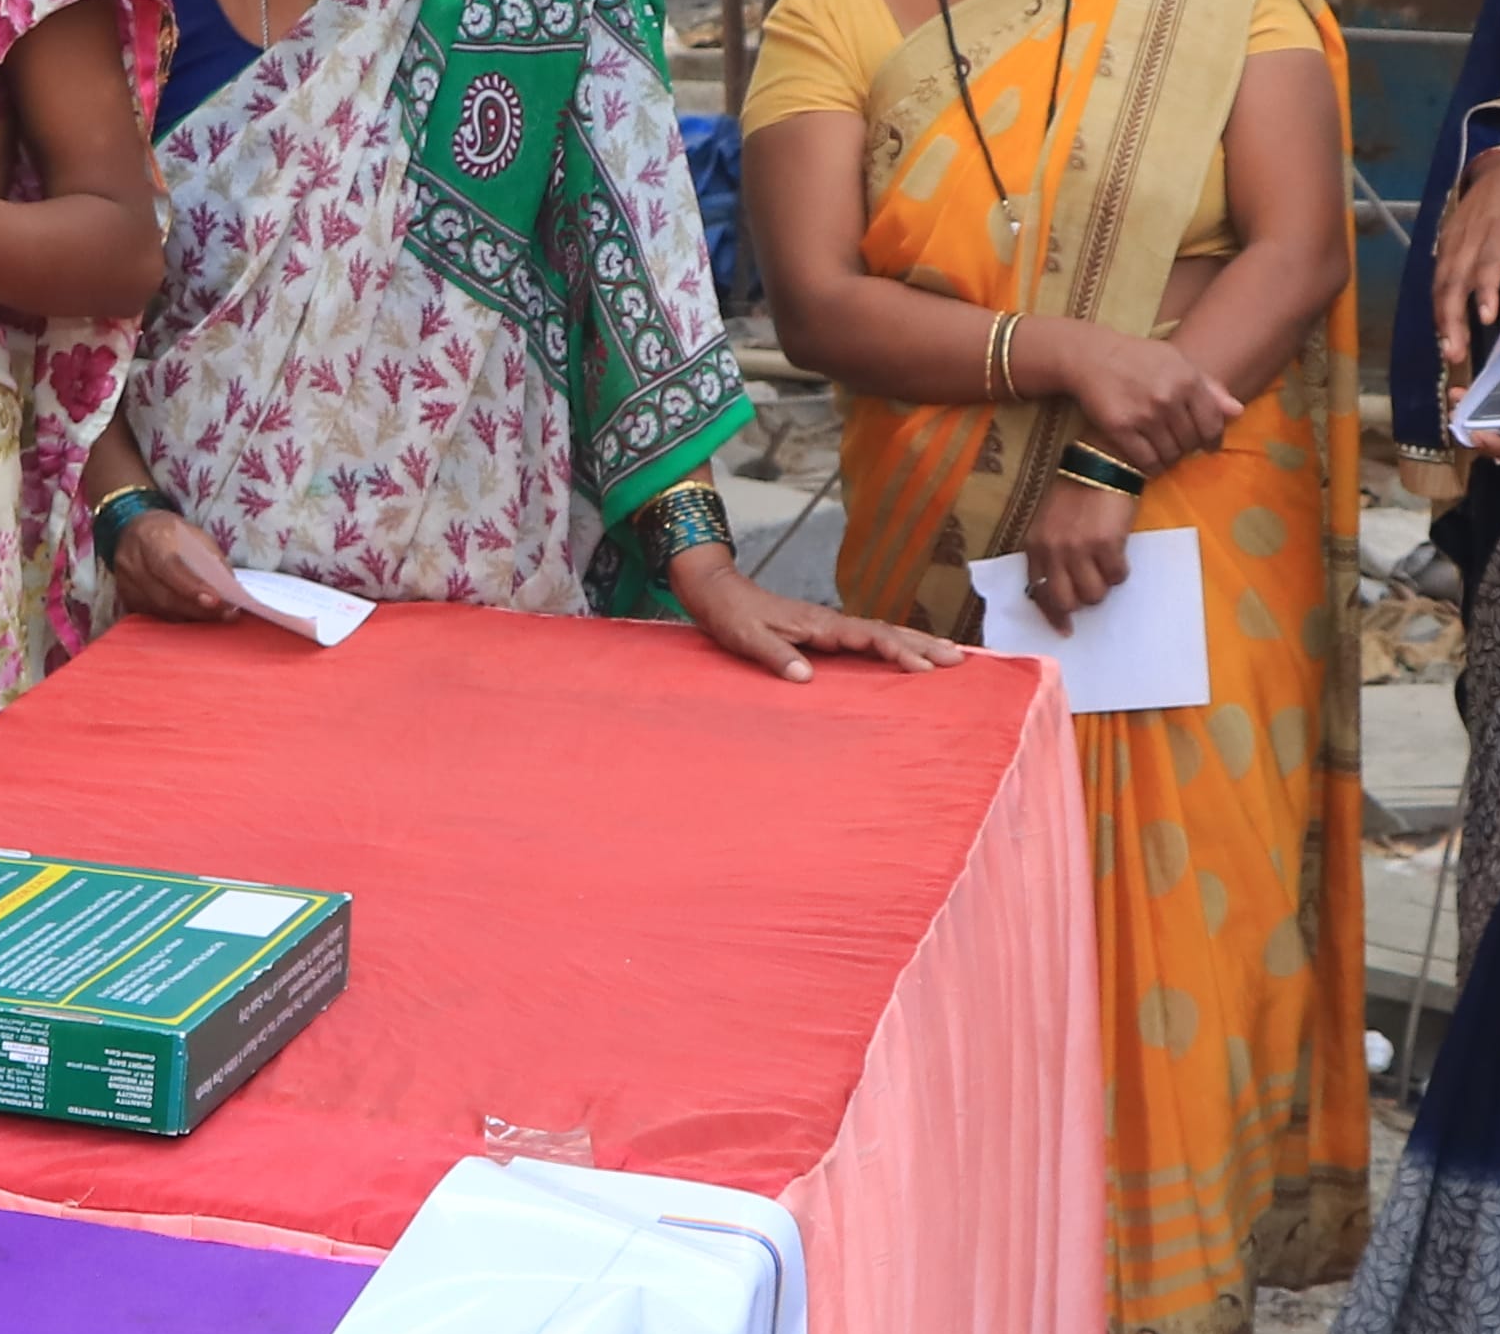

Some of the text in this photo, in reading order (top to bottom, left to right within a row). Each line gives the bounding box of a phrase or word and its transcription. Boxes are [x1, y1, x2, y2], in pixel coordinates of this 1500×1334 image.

[116, 1090, 152, 1101] CAPACITY
[114, 1097, 151, 1109] QUANTITY
[67, 1105, 107, 1118] MARKETED
